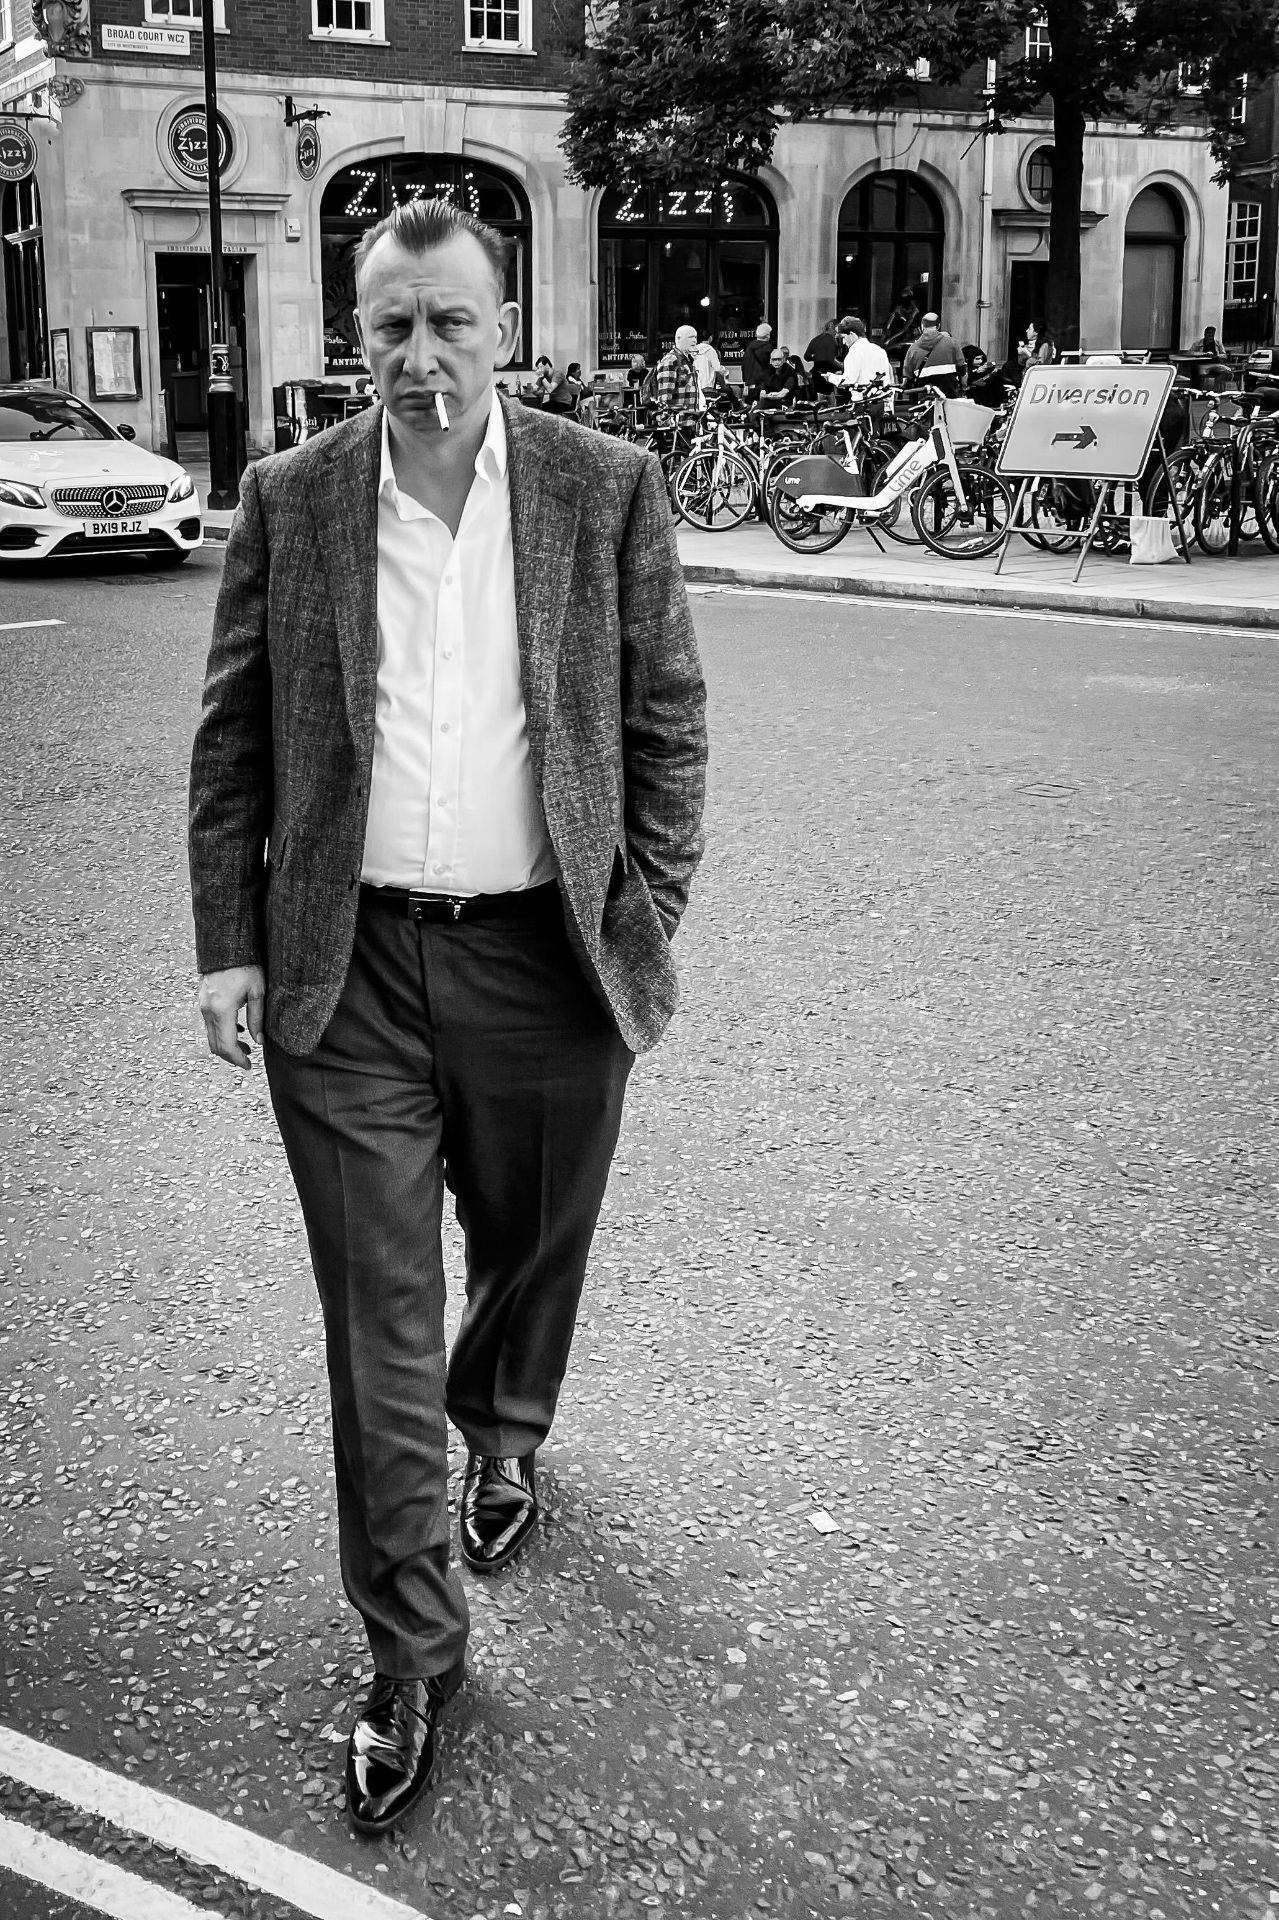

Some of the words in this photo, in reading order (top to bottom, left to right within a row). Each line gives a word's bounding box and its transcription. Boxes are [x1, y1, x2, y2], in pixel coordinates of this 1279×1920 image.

[107, 28, 135, 40] BROAD
[137, 31, 164, 42] COURT
[167, 33, 185, 44] WC2
[177, 137, 208, 152] Zizz
[0, 146, 27, 160] izzi
[344, 169, 480, 219] Zizzi
[332, 358, 364, 366] ANTIPA
[1029, 382, 1151, 406] Diversion
[92, 522, 119, 535] BX19
[120, 520, 142, 533] RJZ
